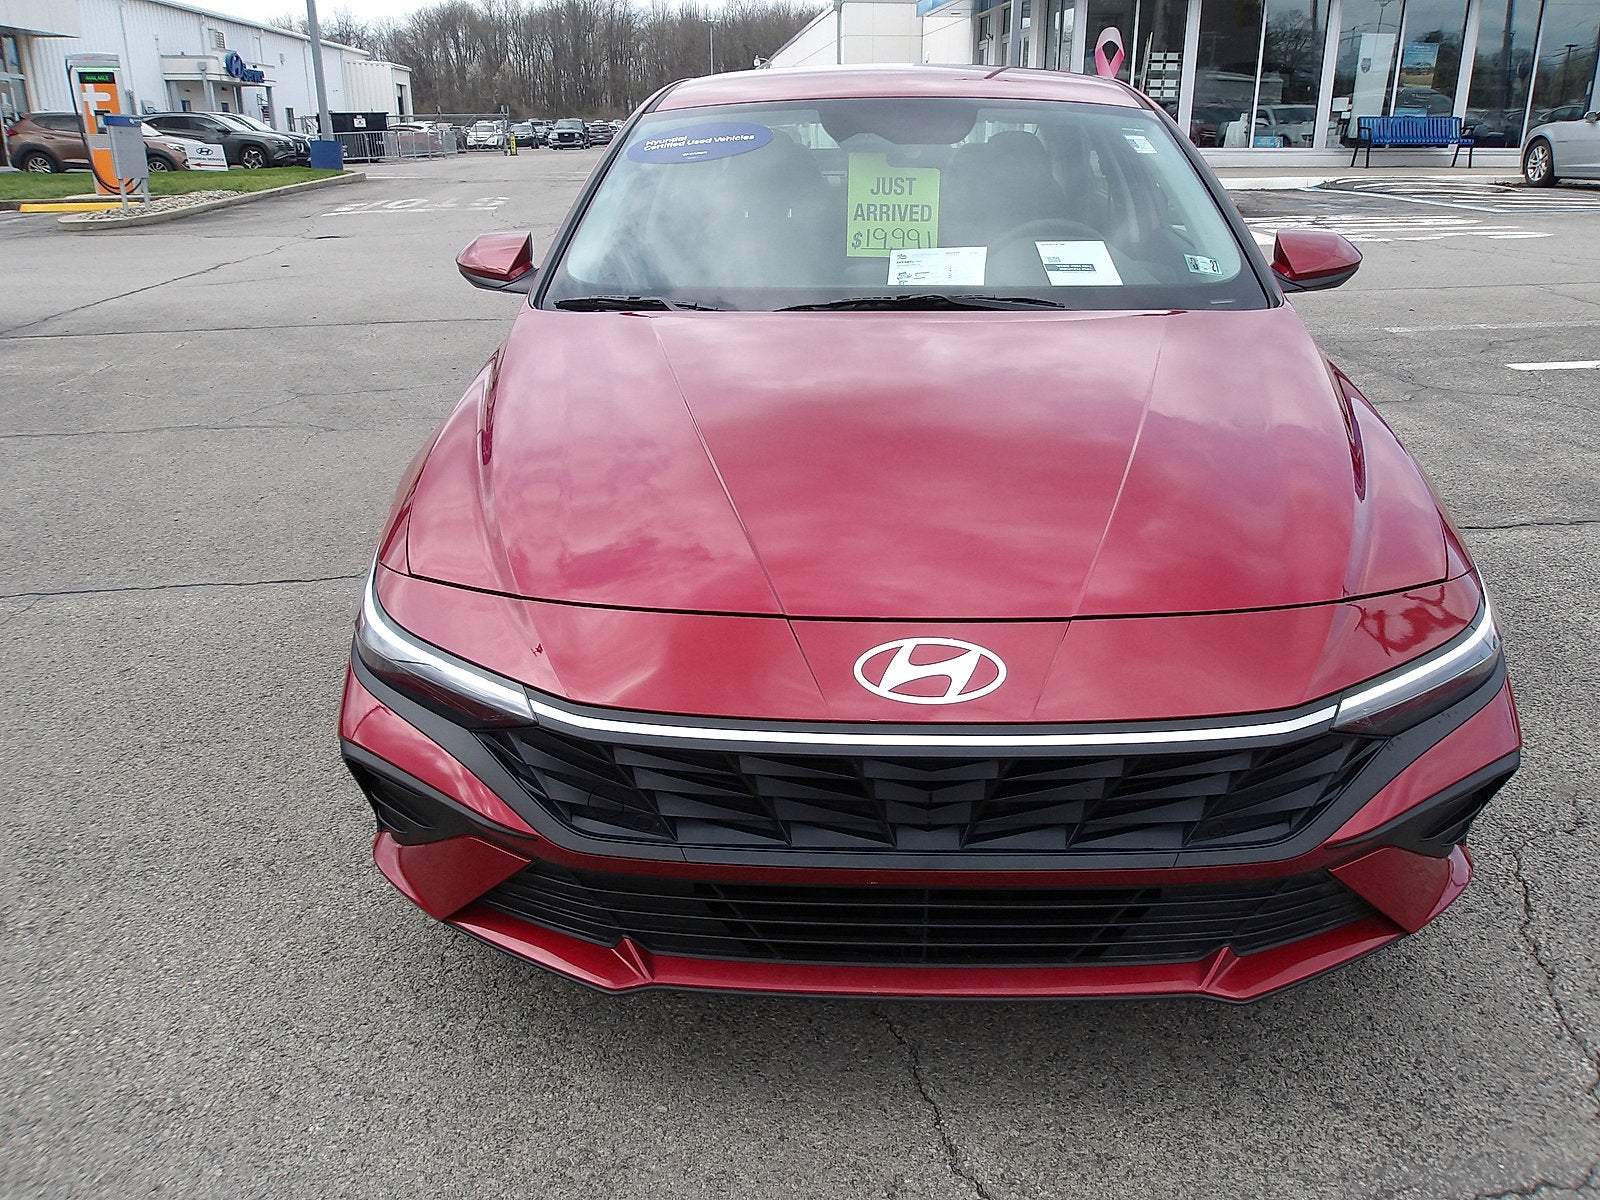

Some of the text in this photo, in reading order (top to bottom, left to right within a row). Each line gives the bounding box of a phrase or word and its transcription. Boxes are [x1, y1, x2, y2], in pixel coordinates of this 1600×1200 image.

[643, 134, 755, 151] Certified Used Vehicles
[645, 135, 688, 146] Hyundai
[870, 177, 917, 196] JUST
[853, 203, 933, 222] ARRIVED
